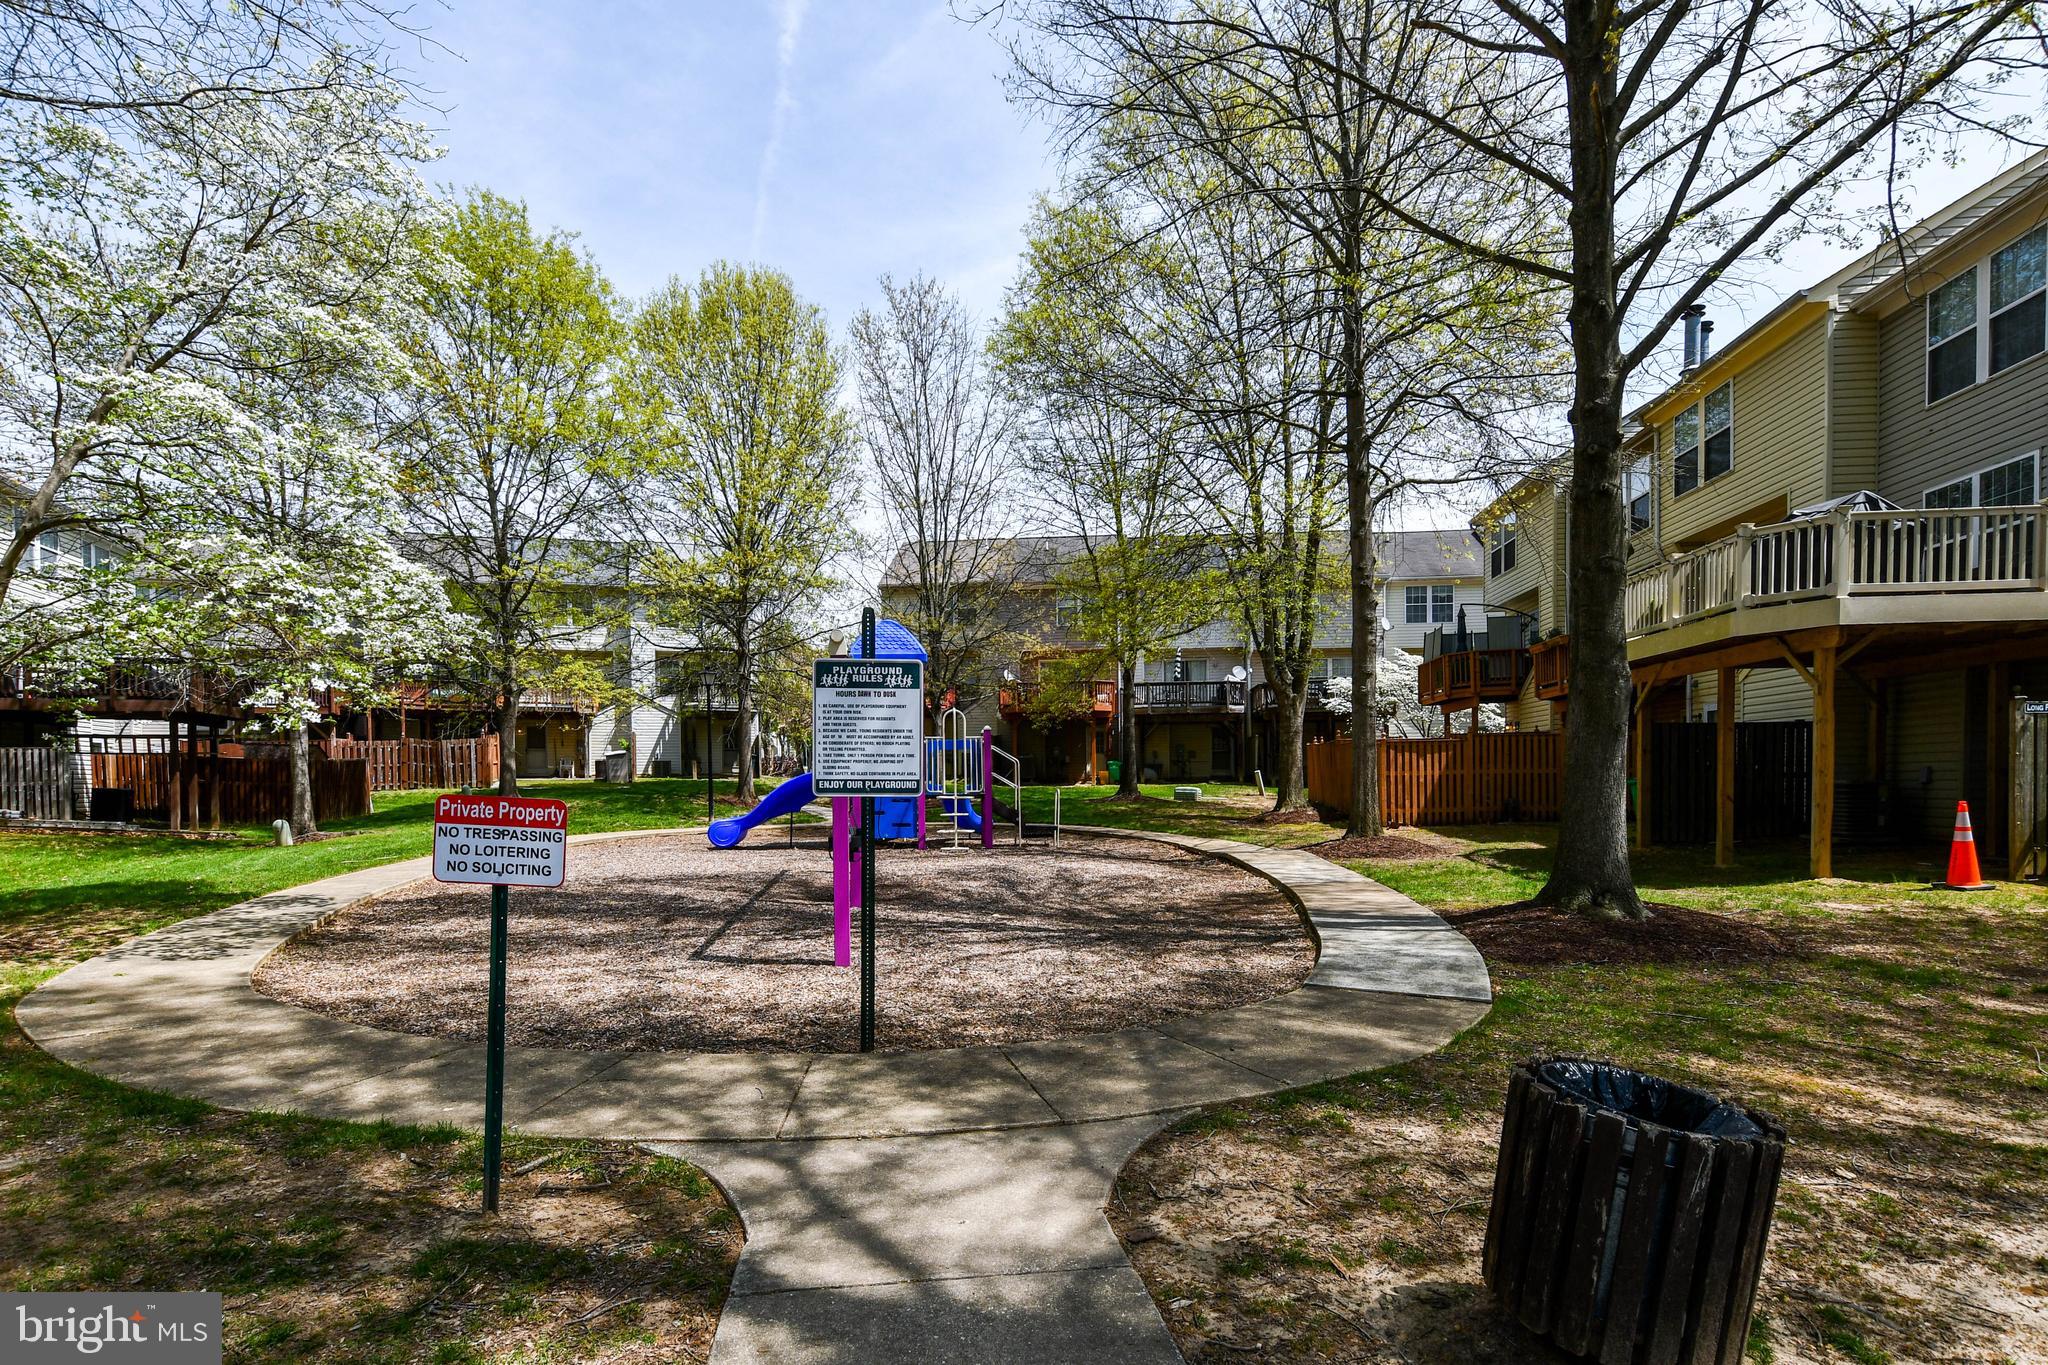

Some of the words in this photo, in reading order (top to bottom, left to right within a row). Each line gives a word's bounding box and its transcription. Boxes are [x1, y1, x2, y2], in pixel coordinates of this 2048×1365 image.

[832, 666, 903, 674] PLAYGROUND
[440, 799, 494, 818] Private
[499, 802, 564, 826] Property
[438, 826, 459, 838] NO
[464, 828, 562, 843] TRESPASSING
[449, 844, 470, 855] NO
[475, 845, 550, 859] LOITERING
[447, 861, 468, 872] NO
[472, 862, 552, 876] SOLICITING
